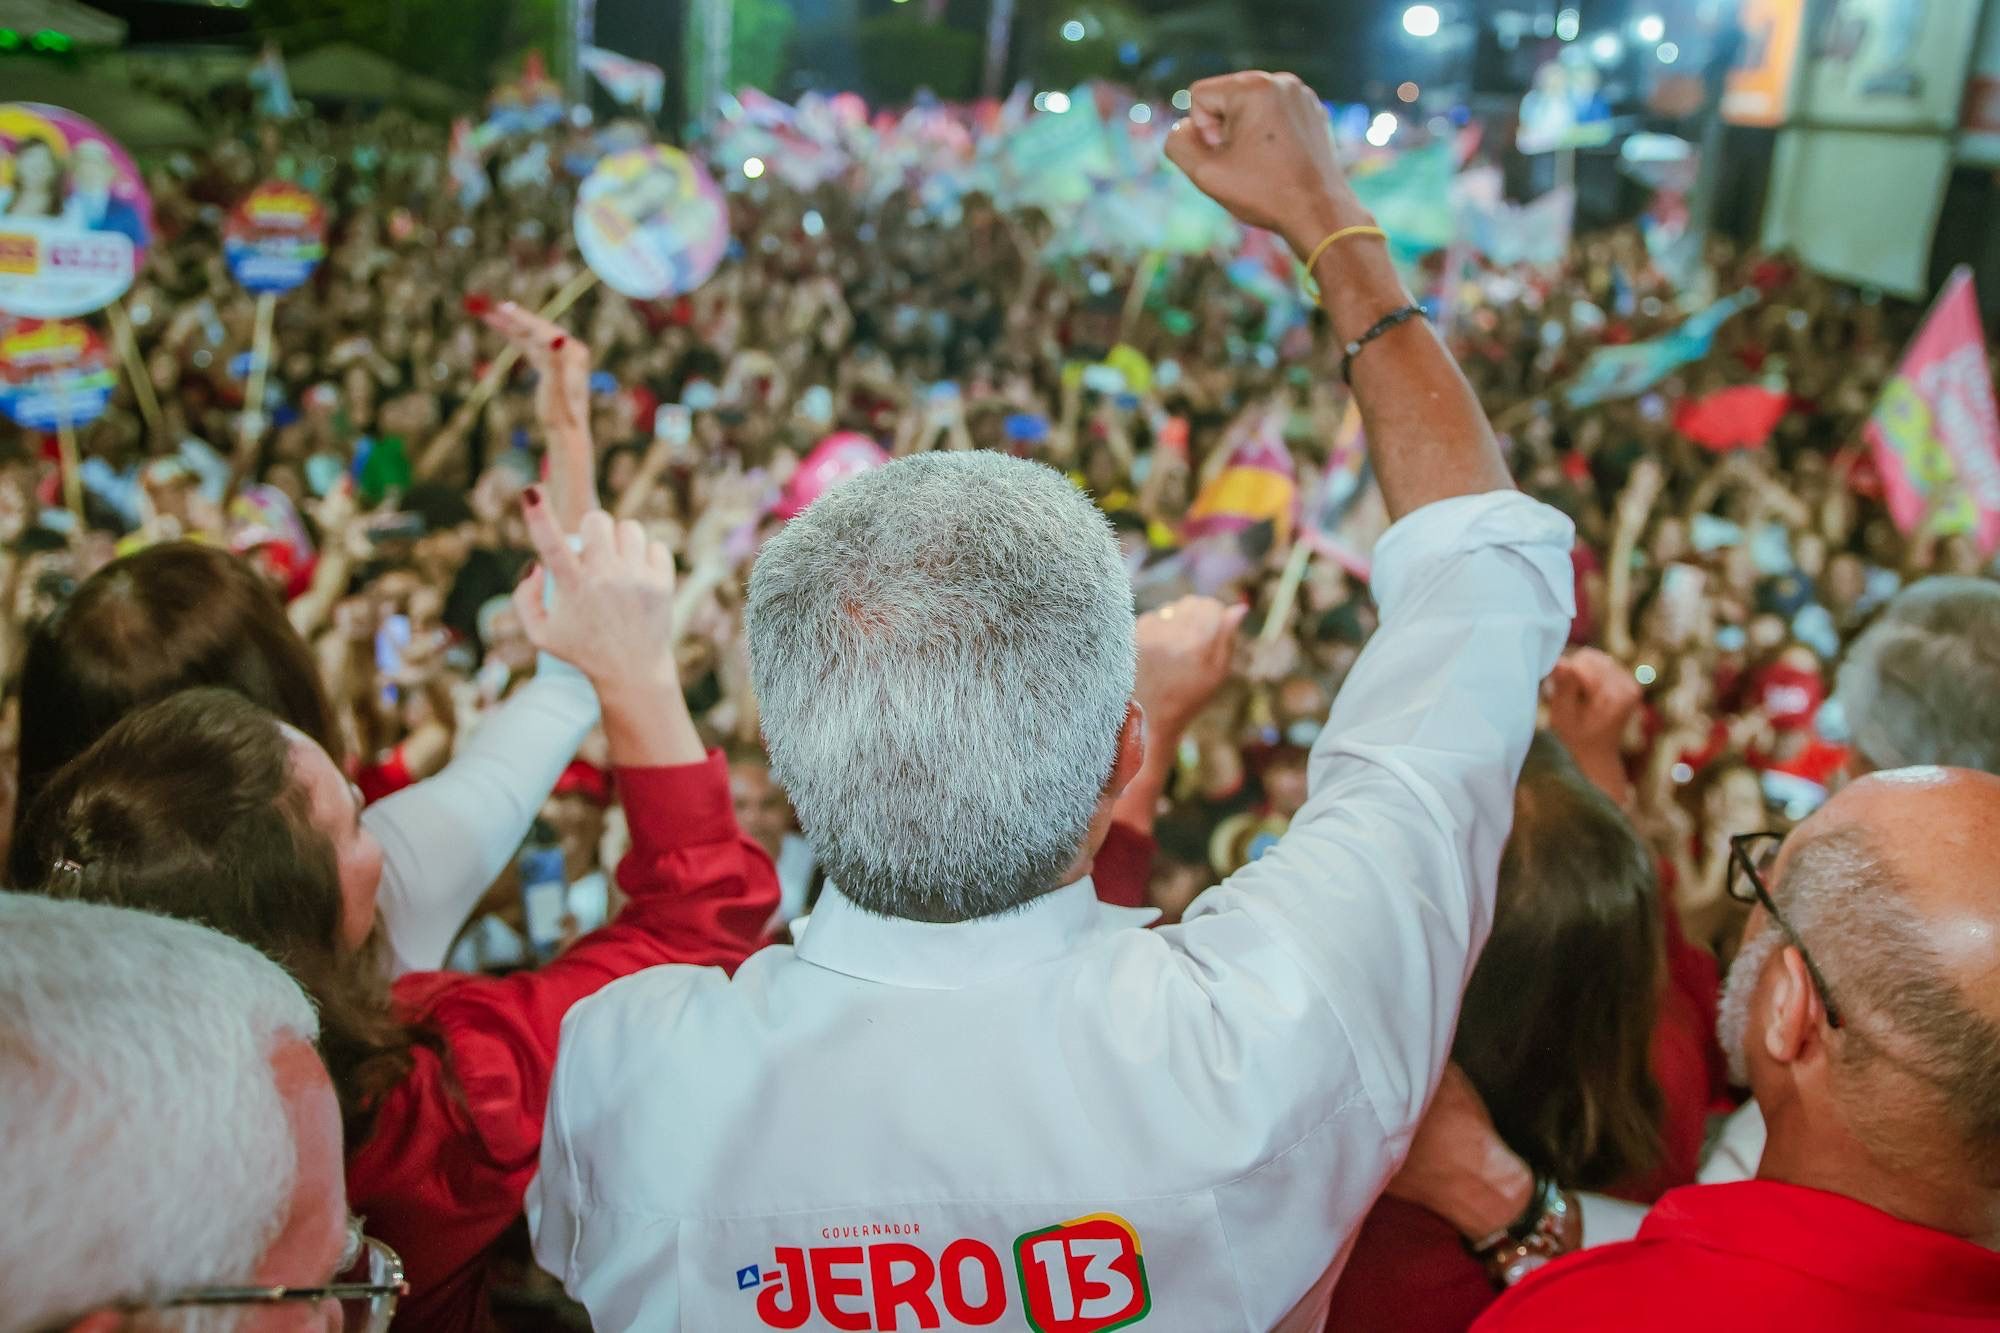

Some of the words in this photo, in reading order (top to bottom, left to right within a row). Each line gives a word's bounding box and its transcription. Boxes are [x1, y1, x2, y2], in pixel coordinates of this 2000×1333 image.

[822, 1223, 921, 1240] GOVERNADOR
[756, 1238, 1007, 1332] JERO
[1033, 1238, 1134, 1322] 13
